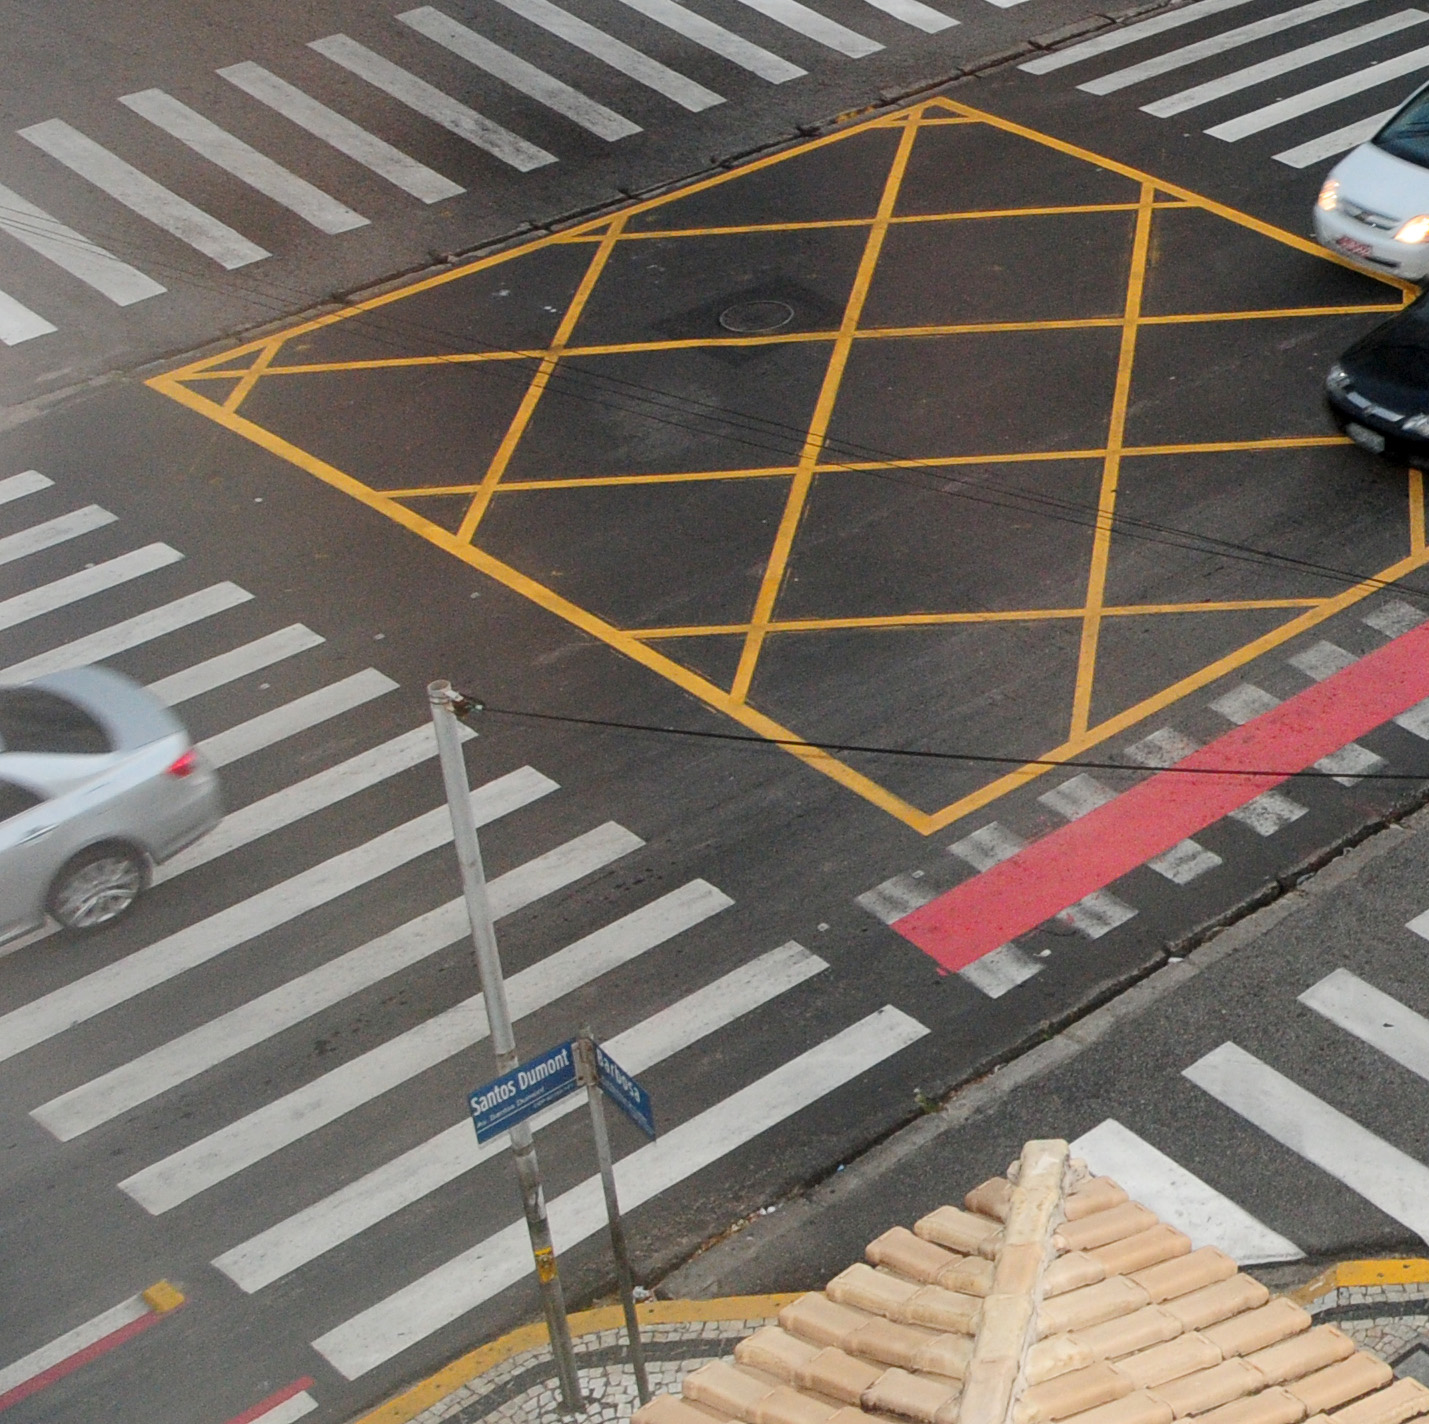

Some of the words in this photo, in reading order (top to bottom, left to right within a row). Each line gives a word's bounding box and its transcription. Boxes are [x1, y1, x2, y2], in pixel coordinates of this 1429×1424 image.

[470, 1080, 516, 1117] Santos
[518, 1048, 570, 1091] Dumont
[596, 1048, 641, 1103] Barbosa
